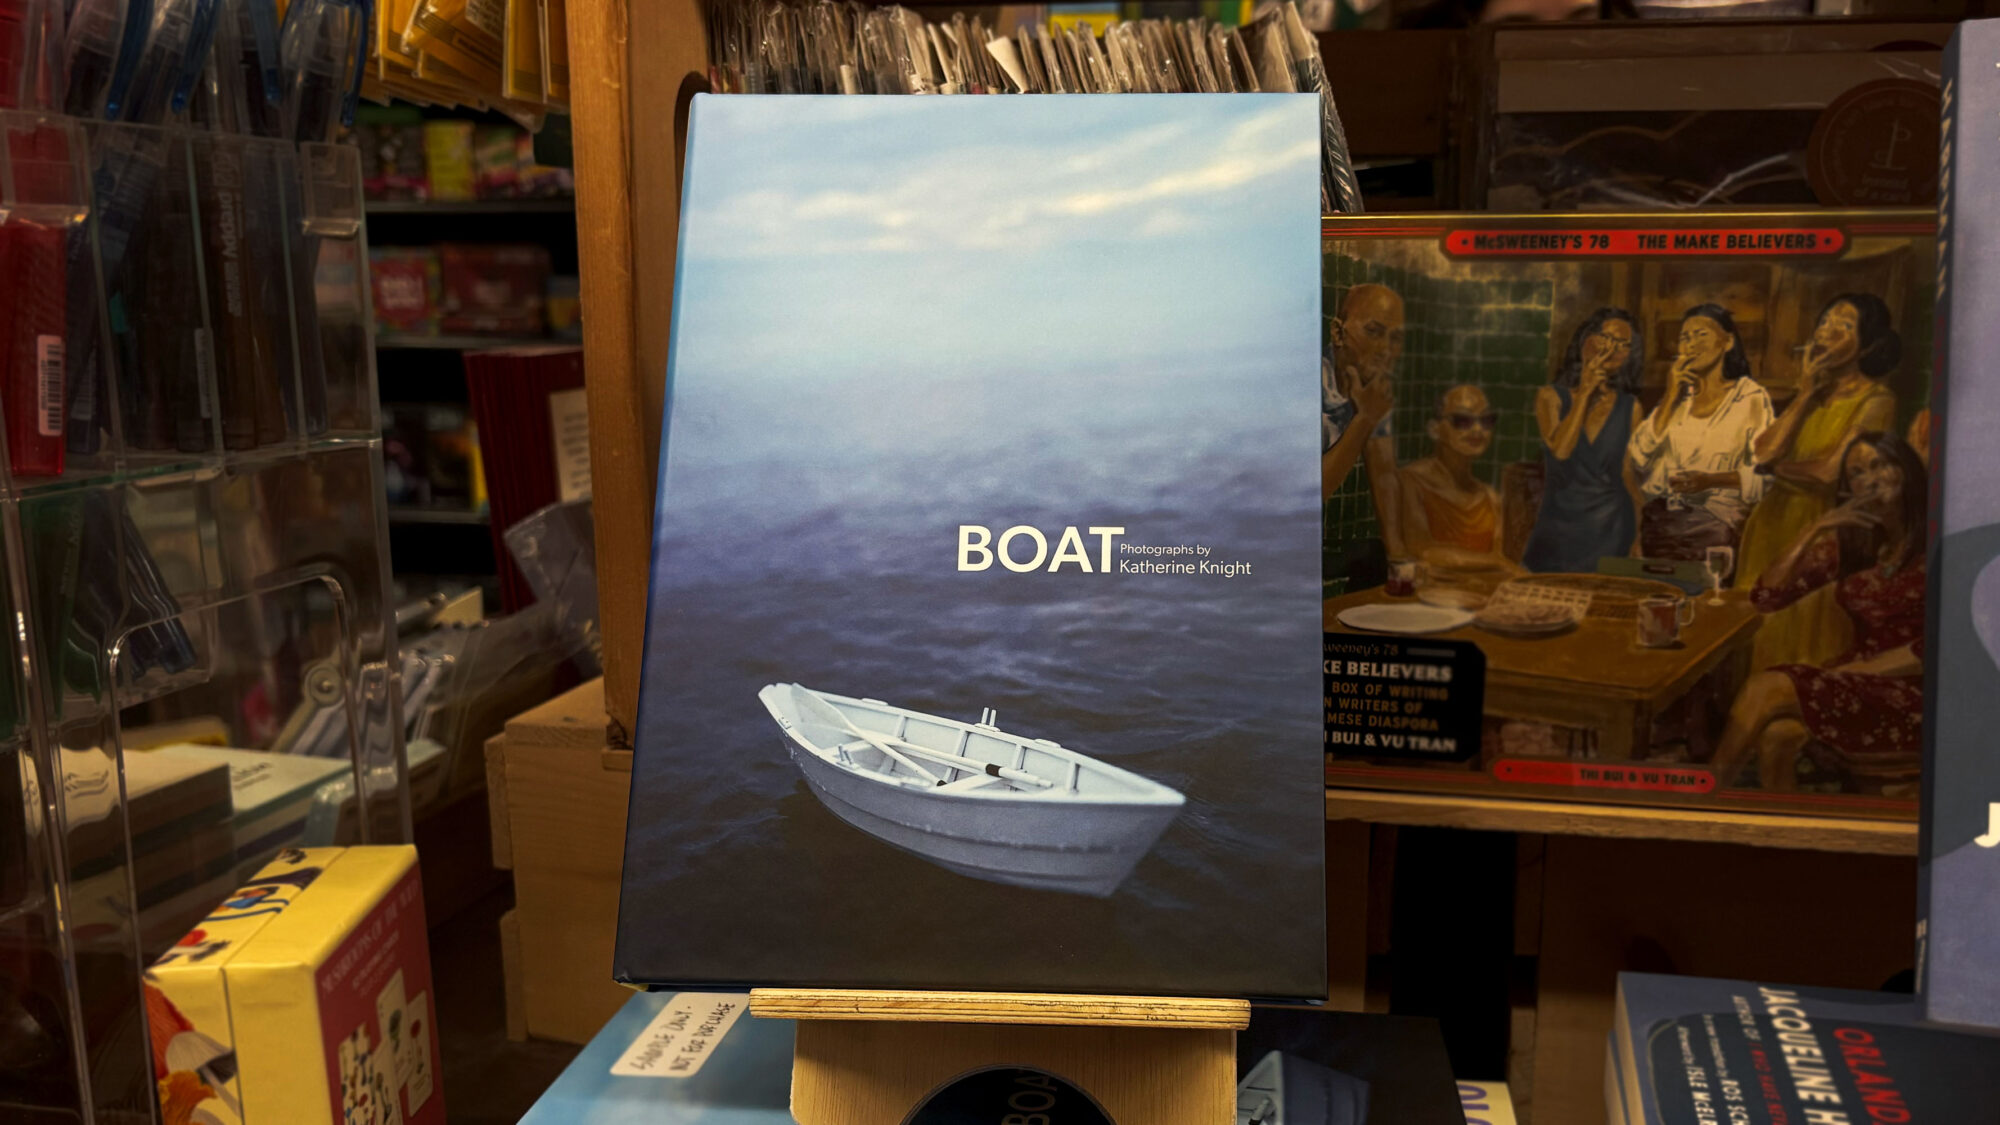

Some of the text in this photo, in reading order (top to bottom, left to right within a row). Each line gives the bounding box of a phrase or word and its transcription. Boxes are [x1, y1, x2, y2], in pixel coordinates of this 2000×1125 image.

[1474, 234, 1817, 250] McSWEENEY'S 78 THE MAKE BELIEVERS
[956, 524, 1126, 573] BOAT
[1120, 543, 1212, 557] Photographs by
[1119, 559, 1252, 578] Katherine Knight
[1384, 643, 1400, 656] 78
[1347, 660, 1453, 683] BELIEVERS
[1332, 681, 1450, 702] BOX OF WRITING
[1338, 697, 1399, 714] WRITERS
[1404, 701, 1424, 715] OF
[1368, 714, 1440, 732] DIASPORA
[1332, 730, 1361, 746] BUI
[1364, 733, 1378, 747] &
[1380, 733, 1406, 749] VU
[1407, 735, 1458, 752] TRAN
[1579, 768, 1600, 781] THI
[1603, 769, 1625, 782] BUI
[1642, 772, 1660, 785] VU
[1664, 773, 1696, 786] TRAN
[680, 1038, 708, 1054] FOR
[1757, 986, 1852, 1125] JACQUELINE H
[668, 1055, 696, 1071] NOT
[1686, 1065, 1709, 1089] ISLE
[1832, 1026, 1912, 1125] ORLAND
[1001, 1070, 1058, 1125] BOA
[1719, 1079, 1744, 1102] ROS
